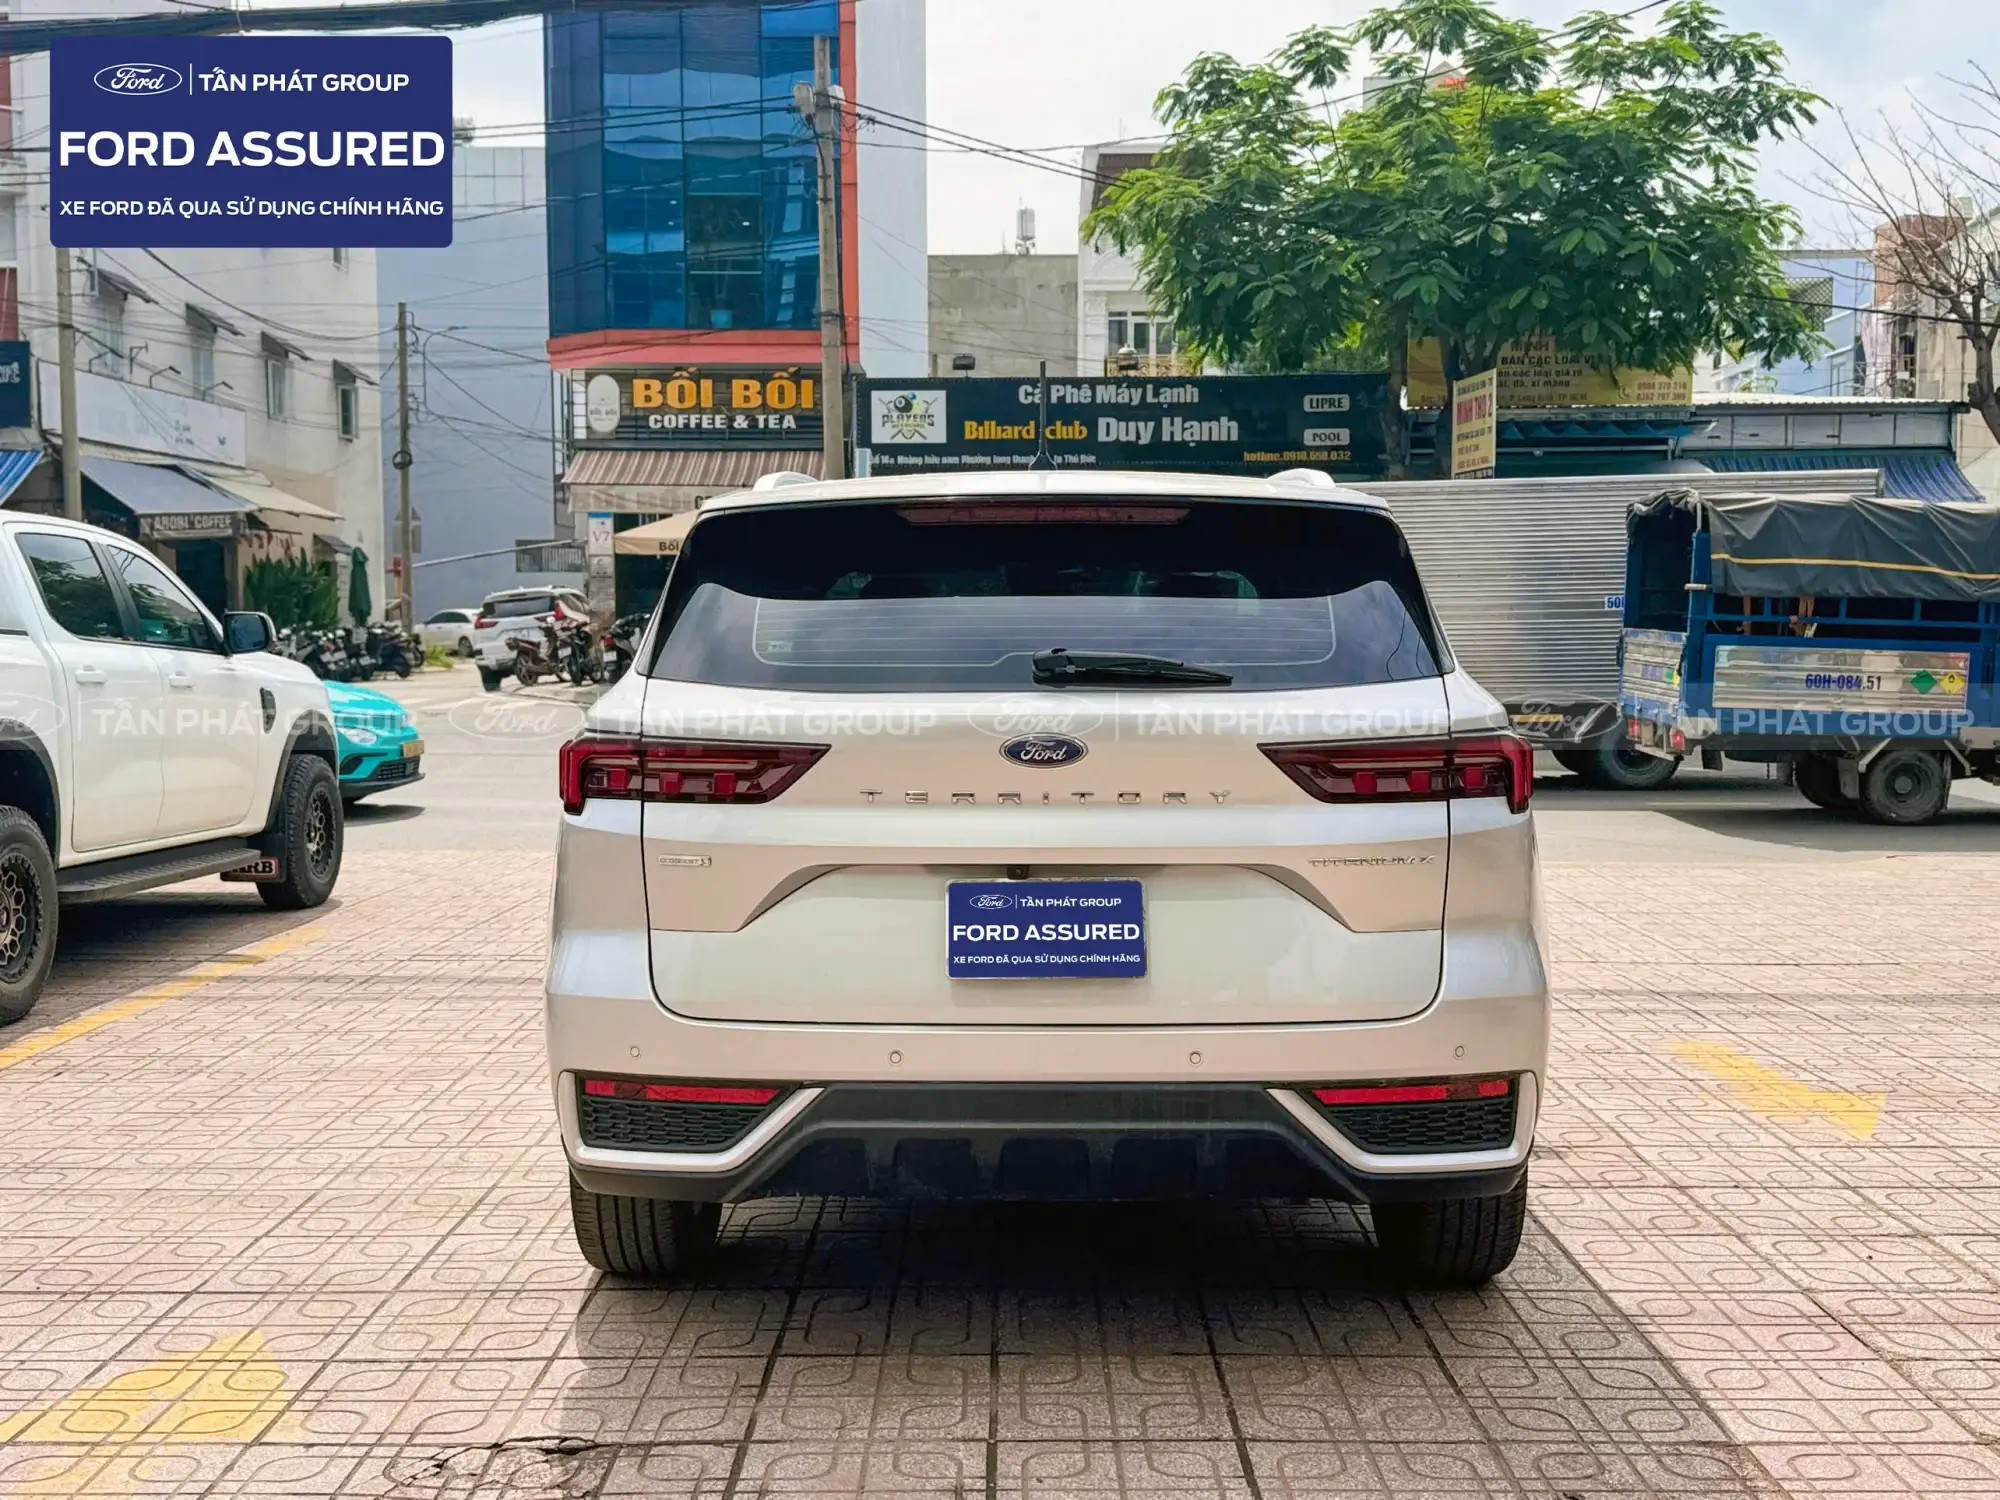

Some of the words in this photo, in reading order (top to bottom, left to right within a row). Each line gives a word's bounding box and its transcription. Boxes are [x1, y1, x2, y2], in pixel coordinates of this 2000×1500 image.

[632, 367, 713, 408] BỐI
[732, 367, 813, 408] BỐI
[1050, 384, 1092, 404] Phê
[1096, 382, 1142, 407] Máy
[1146, 384, 1199, 408] Lạnh
[649, 414, 726, 428] COFFEE
[733, 414, 749, 428] &
[756, 414, 796, 428] TEA
[1044, 420, 1088, 440] club
[1097, 417, 1155, 445] Duy
[1162, 416, 1239, 447] Hạnh
[1312, 432, 1342, 443] POOL
[194, 514, 232, 529] COFFEE
[1020, 738, 1068, 762] Ford
[859, 788, 1232, 805] TERRITORY
